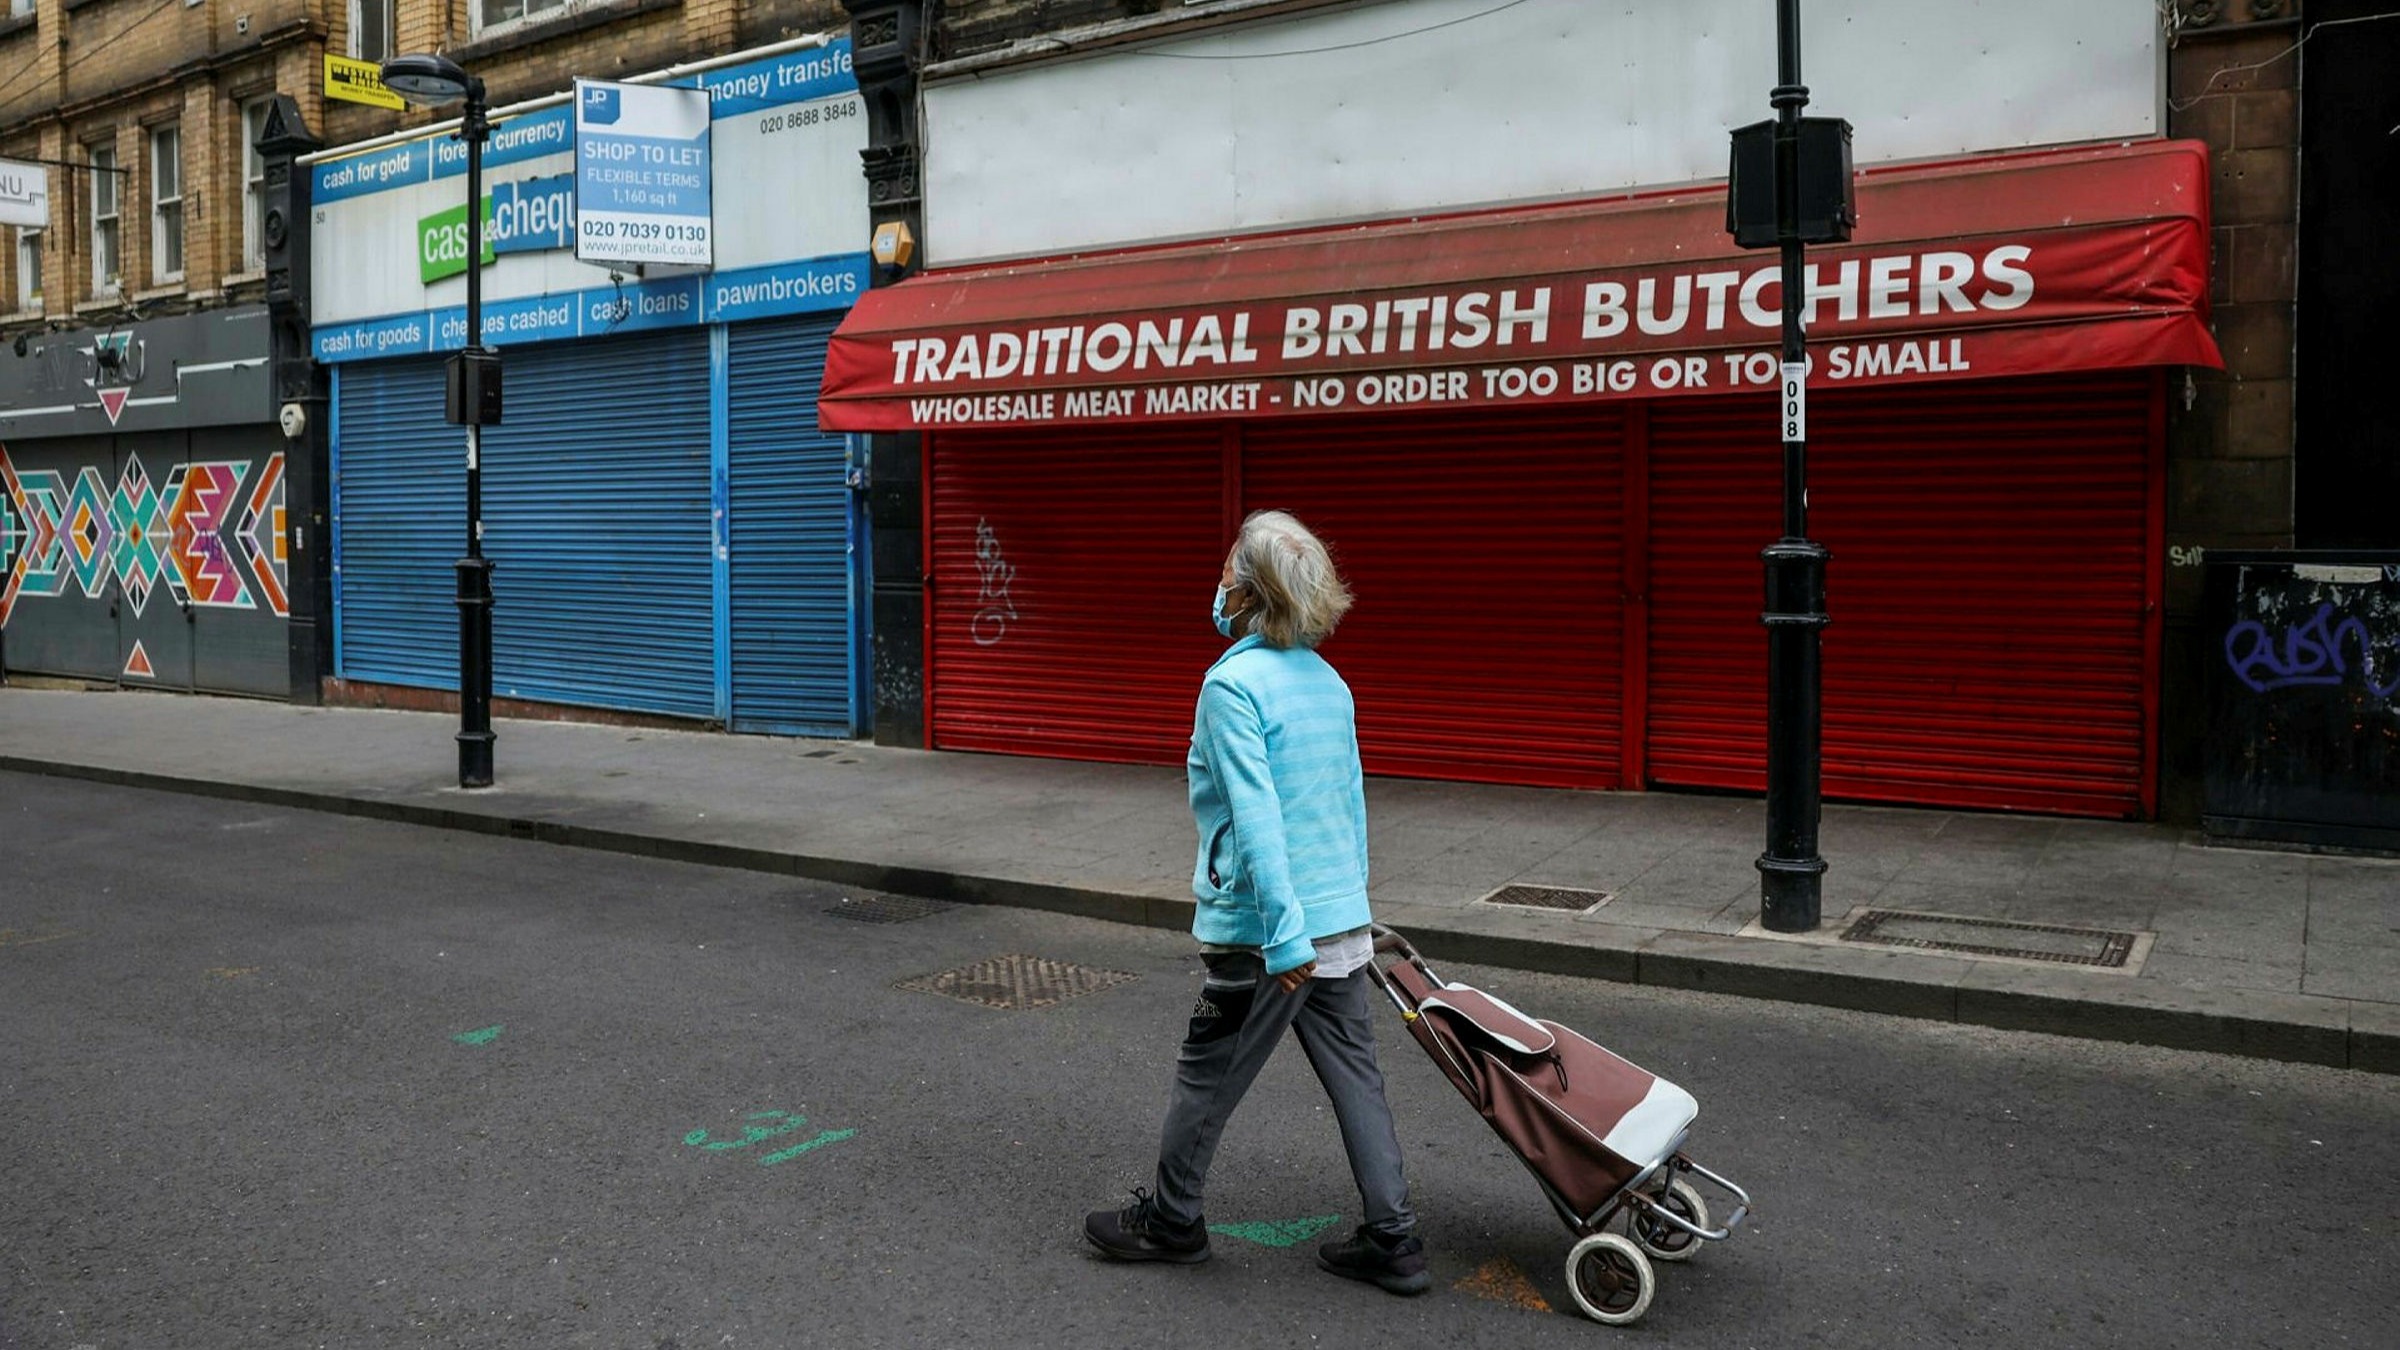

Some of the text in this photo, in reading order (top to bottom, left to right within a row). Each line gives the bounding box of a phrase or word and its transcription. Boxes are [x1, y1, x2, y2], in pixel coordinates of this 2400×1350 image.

[705, 50, 853, 102] money transfe
[585, 90, 607, 104] JP
[760, 101, 857, 134] 020 8688 3848
[438, 119, 566, 164] foren currency
[584, 141, 703, 166] SHOP TO LET
[323, 153, 410, 190] cash for gold
[587, 168, 700, 188] FLEXIBLE TERMS
[649, 193, 664, 208] sq
[668, 193, 677, 205] ft
[424, 221, 485, 264] cas
[583, 220, 706, 241] 020 7039 0130
[584, 241, 706, 257] www.jpretail.co.uk
[591, 292, 690, 321] cash loans
[716, 270, 857, 310] pawnbrokers
[441, 302, 568, 338] cheues cashed
[892, 244, 2036, 385] TRADITIONAL BRITISH BUTCHERS
[320, 322, 421, 353] cash for goods
[910, 394, 1054, 424] WHOLESALE
[1063, 389, 1136, 417] MEAT
[1144, 383, 1262, 415] MARKET
[1293, 377, 1345, 408] NO
[1356, 368, 1469, 403] ORDER
[1482, 365, 1559, 398] TOO
[1572, 360, 1637, 394] BIG
[1650, 356, 1708, 389] OR
[1828, 338, 1970, 380] SMALL
[1787, 381, 1798, 437] 008
